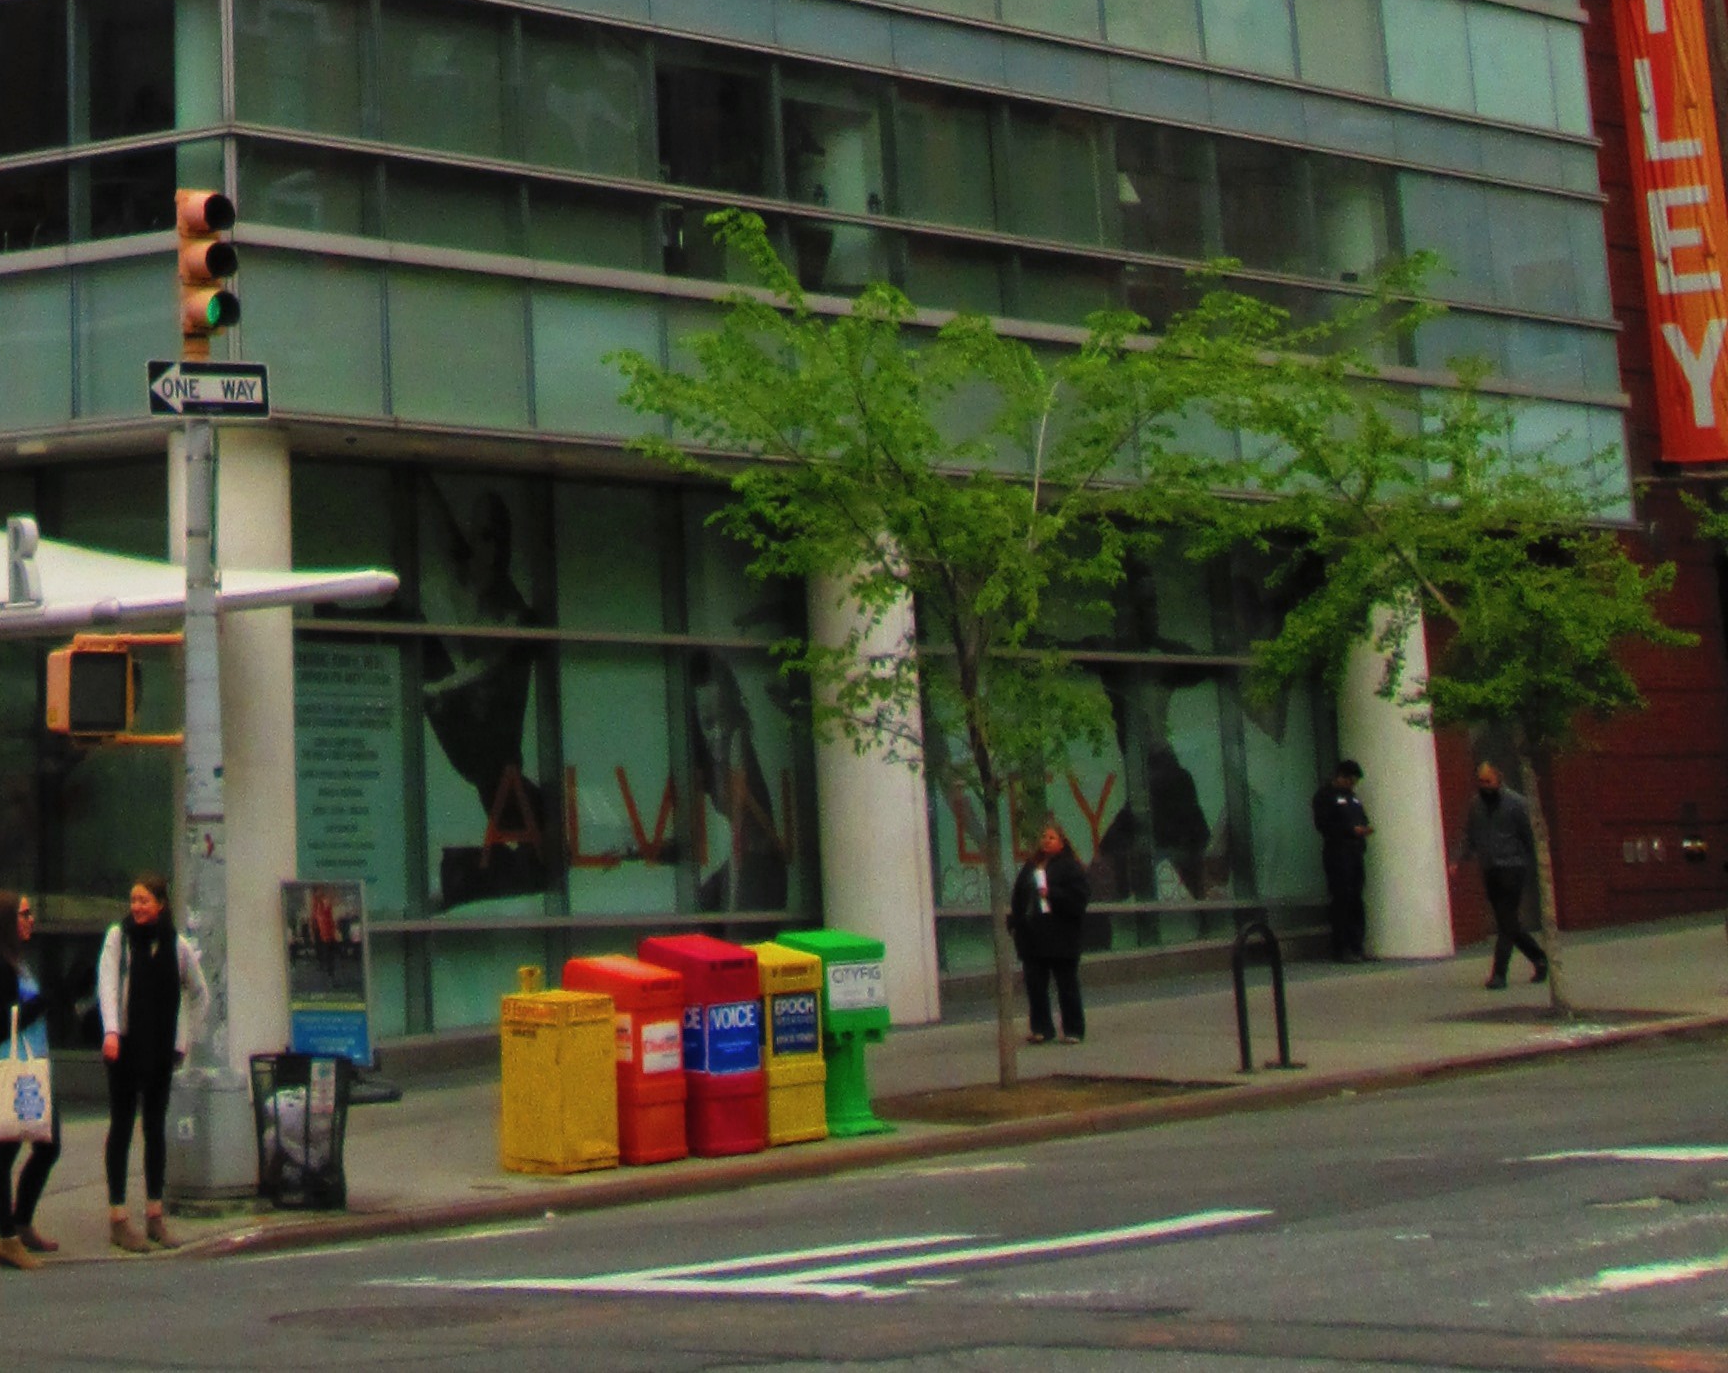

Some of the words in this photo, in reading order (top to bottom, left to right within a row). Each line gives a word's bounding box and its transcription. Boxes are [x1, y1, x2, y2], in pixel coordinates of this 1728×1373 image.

[161, 377, 201, 400] ONE
[220, 378, 257, 401] WAY
[709, 1003, 757, 1031] VOICE
[774, 997, 815, 1016] EPOCH
